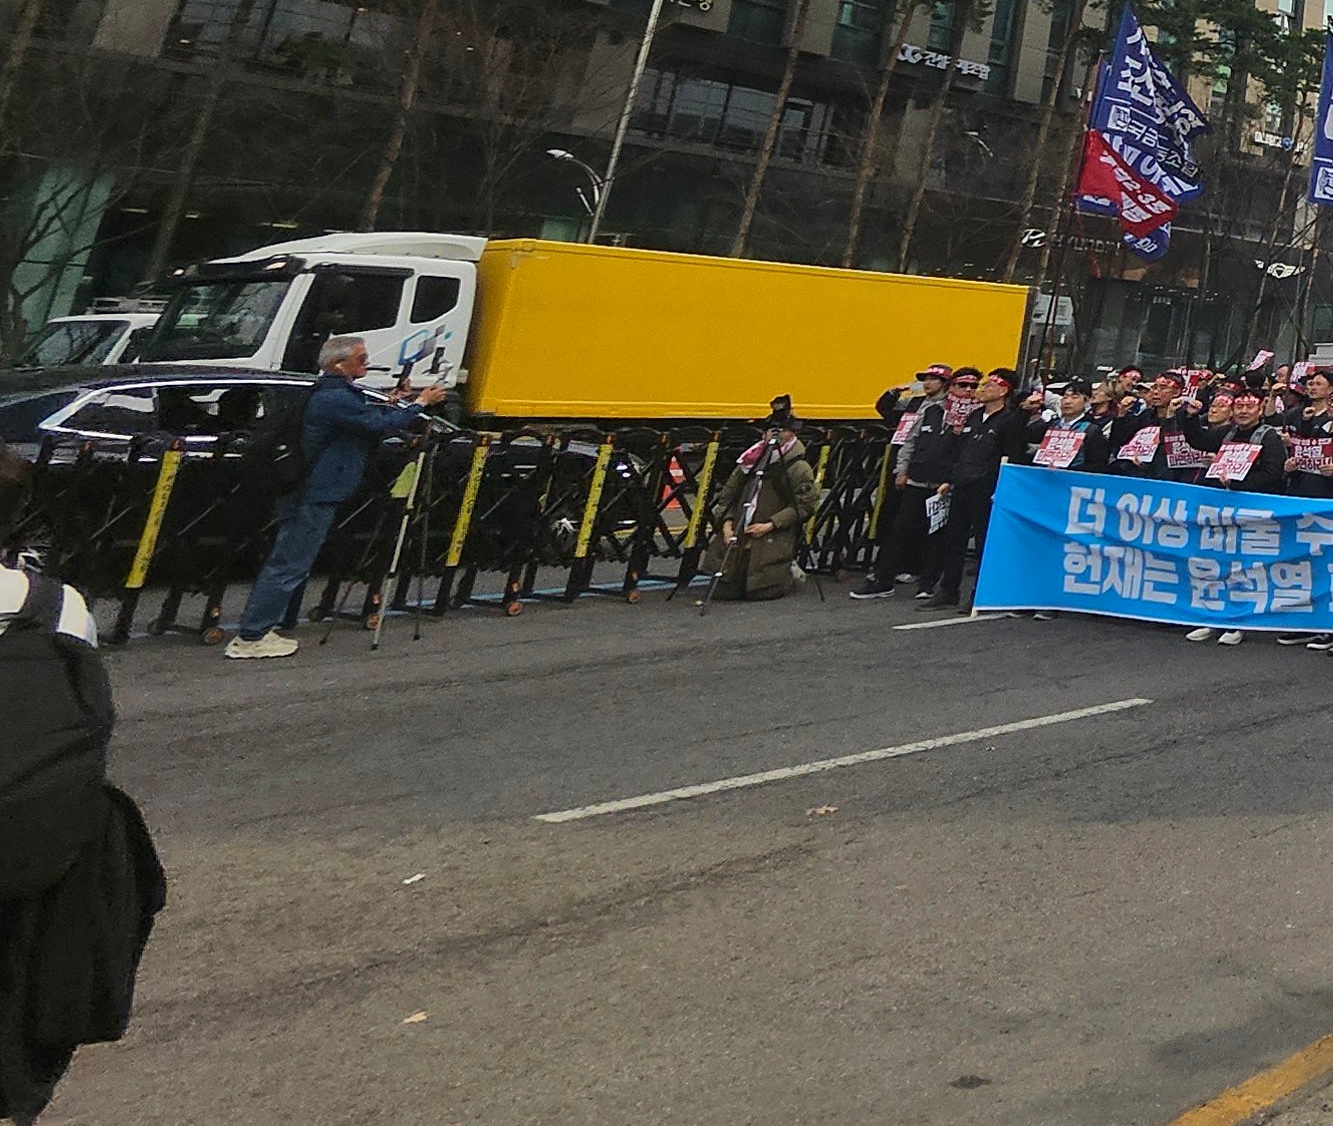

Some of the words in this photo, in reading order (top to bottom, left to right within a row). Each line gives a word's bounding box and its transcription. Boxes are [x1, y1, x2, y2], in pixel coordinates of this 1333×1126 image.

[1066, 486, 1106, 538] 더
[1117, 493, 1189, 548] 이상
[1198, 505, 1281, 557] 미룰
[1063, 541, 1179, 605] 헌재는
[1186, 557, 1314, 616] 윤석열
